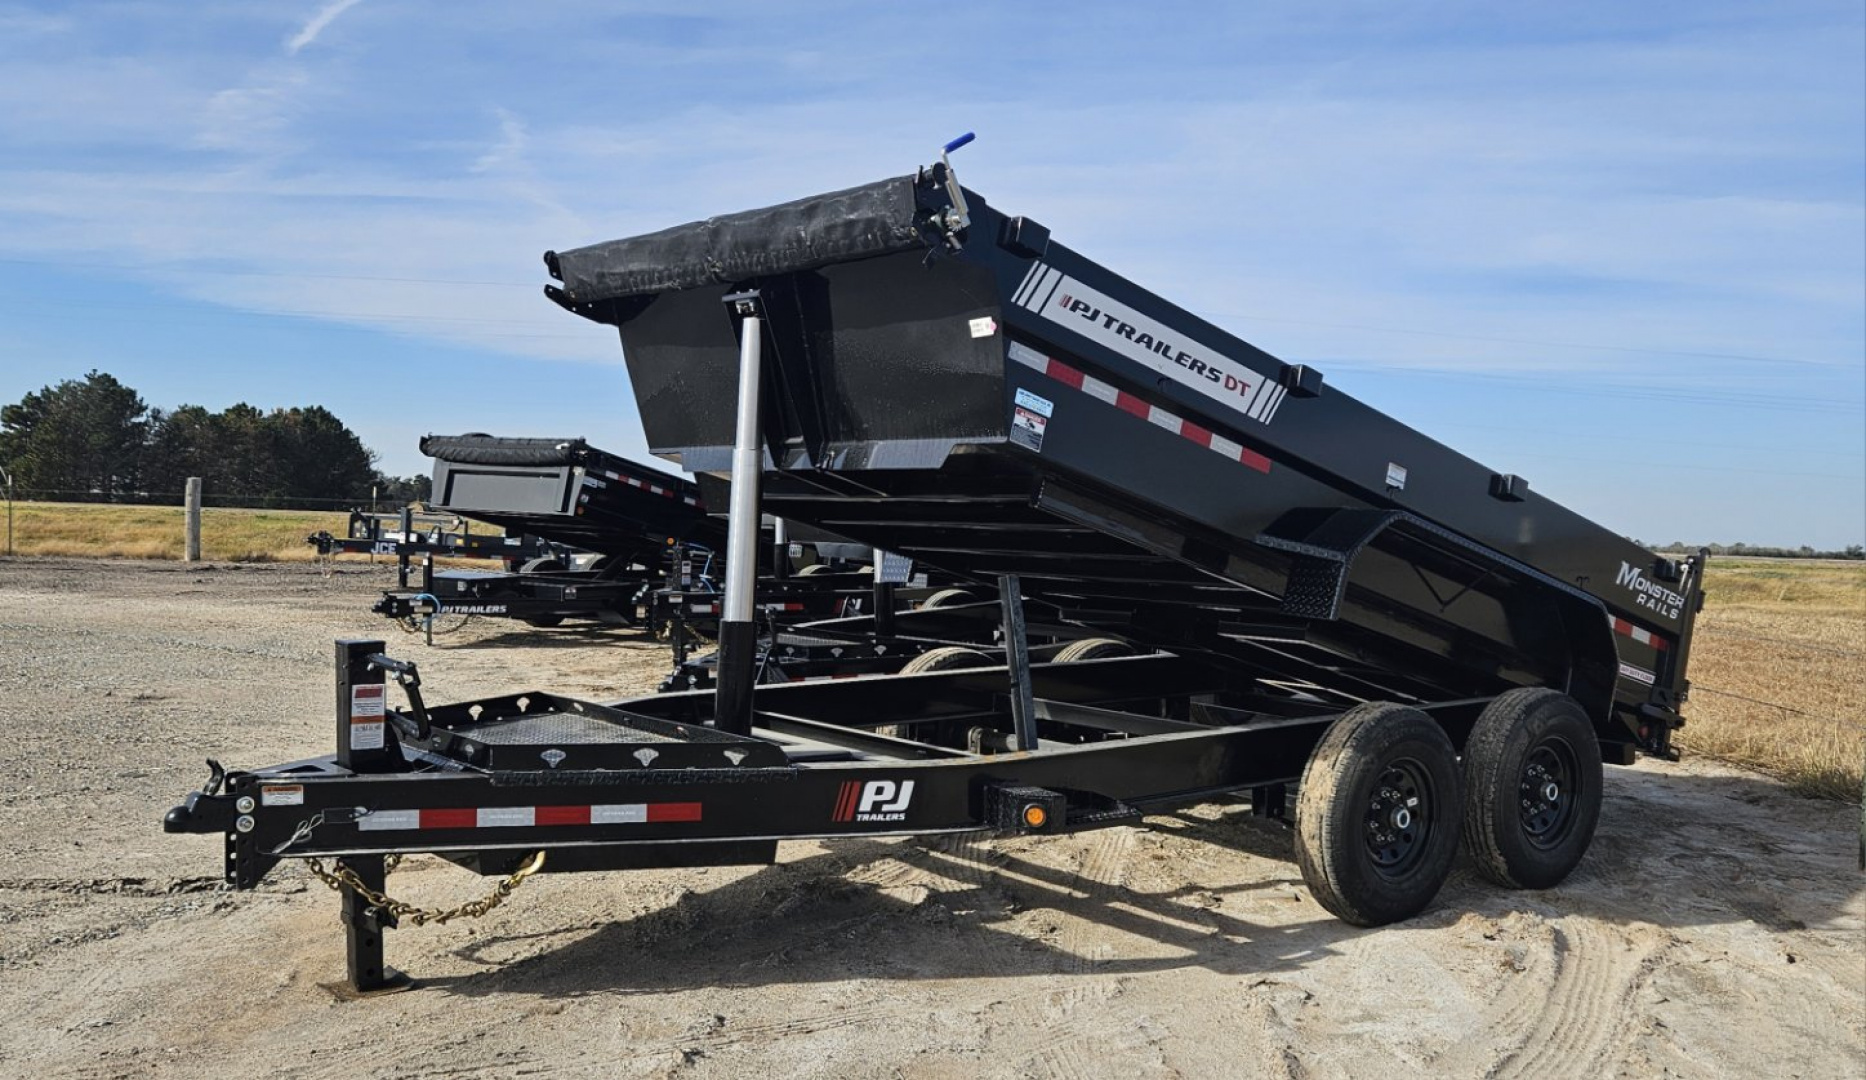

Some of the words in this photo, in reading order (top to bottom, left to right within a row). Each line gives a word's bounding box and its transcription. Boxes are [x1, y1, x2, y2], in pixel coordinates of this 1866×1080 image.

[1070, 299, 1101, 322] PJ
[1103, 314, 1223, 384] TRAILERS
[1224, 373, 1251, 397] DT
[454, 605, 507, 614] TRAILERS
[1637, 593, 1679, 619] RAILS
[859, 780, 915, 812] PJ
[856, 814, 906, 822] TRAILERS
